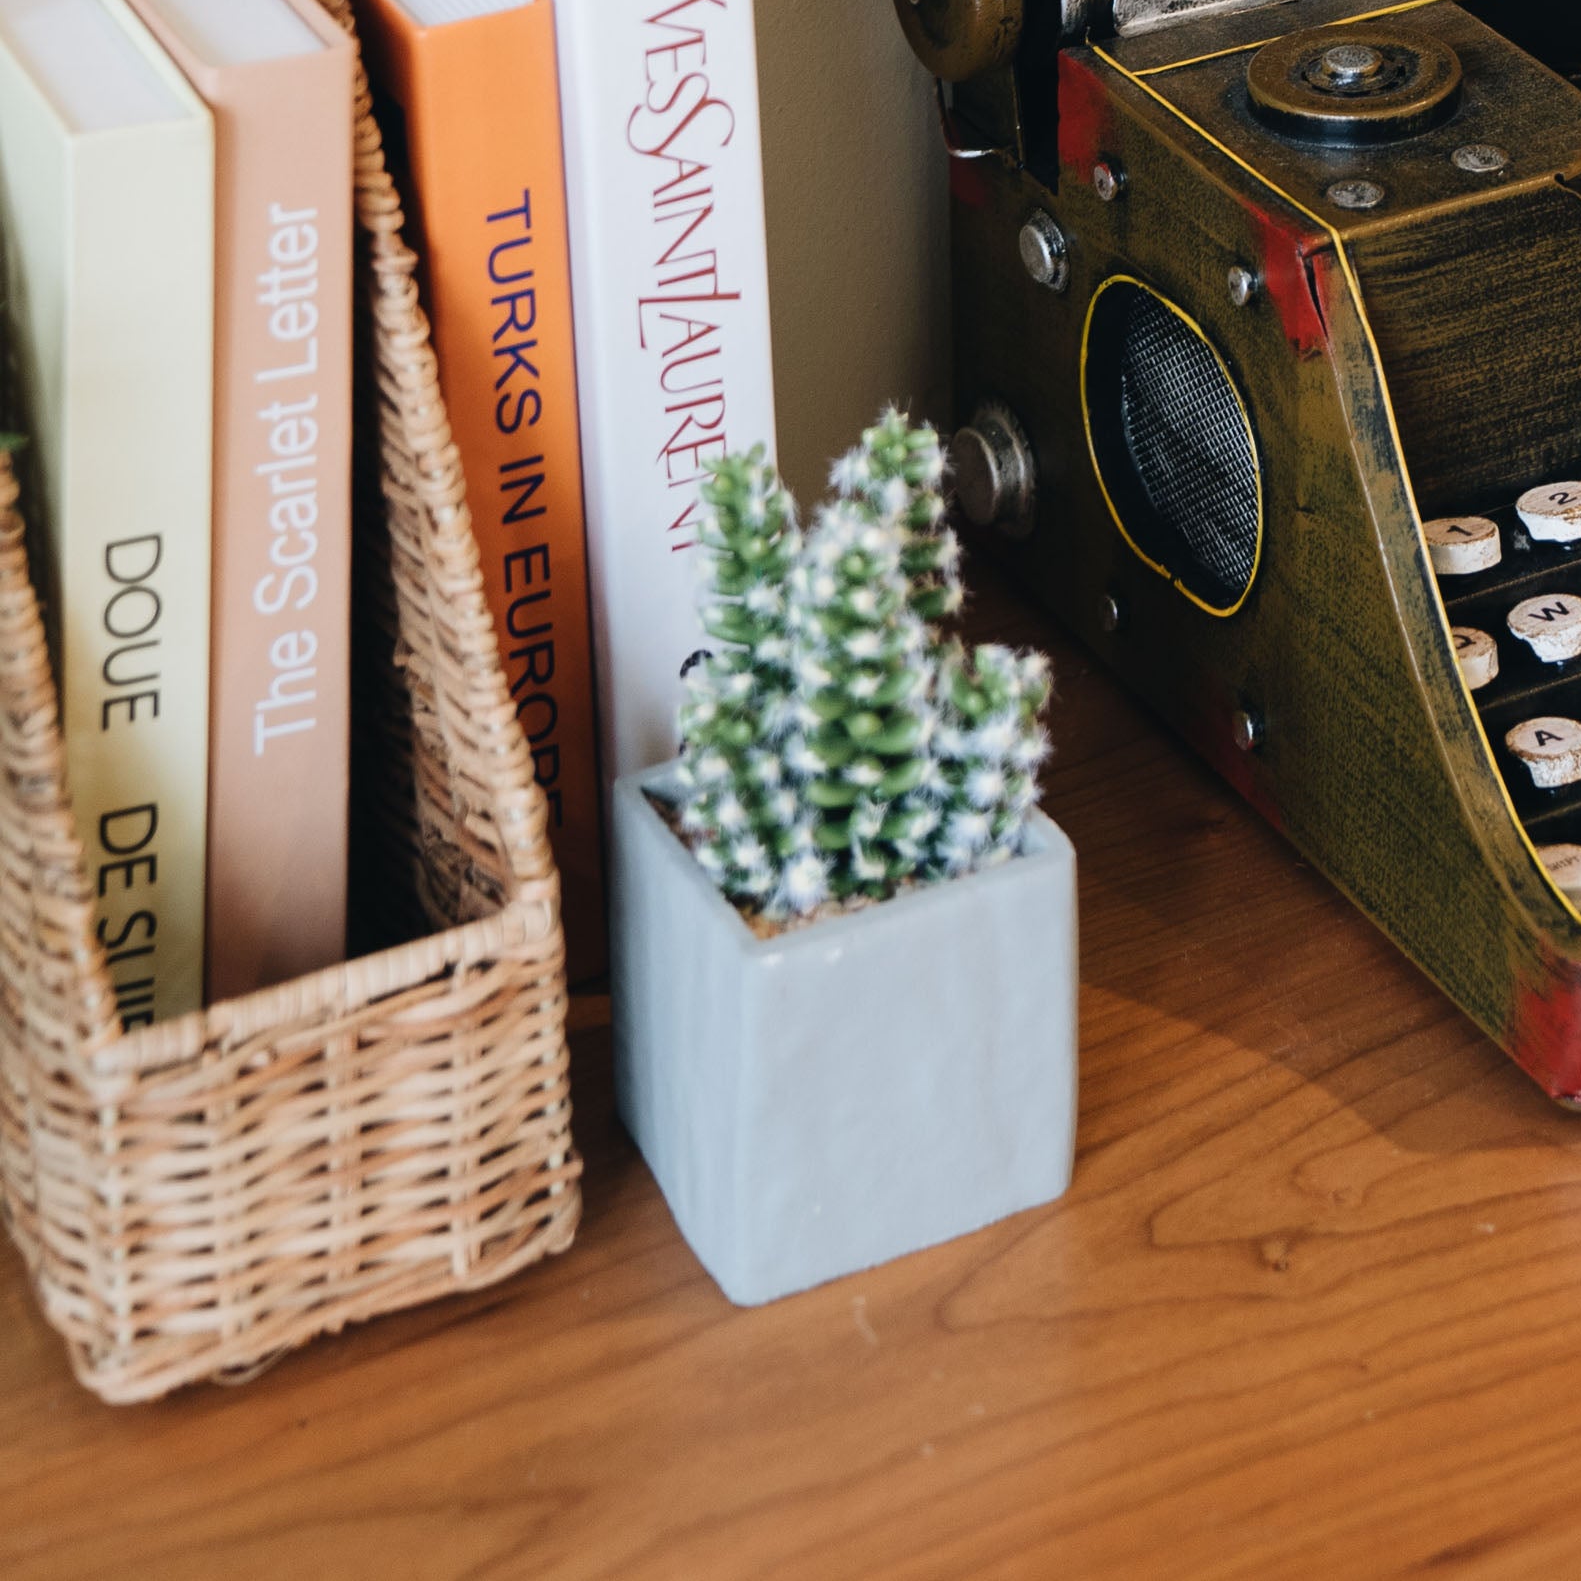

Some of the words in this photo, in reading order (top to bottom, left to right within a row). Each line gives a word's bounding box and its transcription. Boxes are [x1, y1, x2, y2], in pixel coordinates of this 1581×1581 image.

[253, 200, 319, 385] Letter
[486, 187, 541, 435] TURKS
[253, 393, 319, 617] Scarlet
[499, 454, 547, 525] IN
[1447, 525, 1472, 537] 1
[1549, 491, 1577, 506] 2
[101, 532, 162, 732] DOUE
[1528, 601, 1570, 621] W
[253, 630, 318, 756] The
[1534, 729, 1564, 747] A
[98, 802, 158, 899] DE
